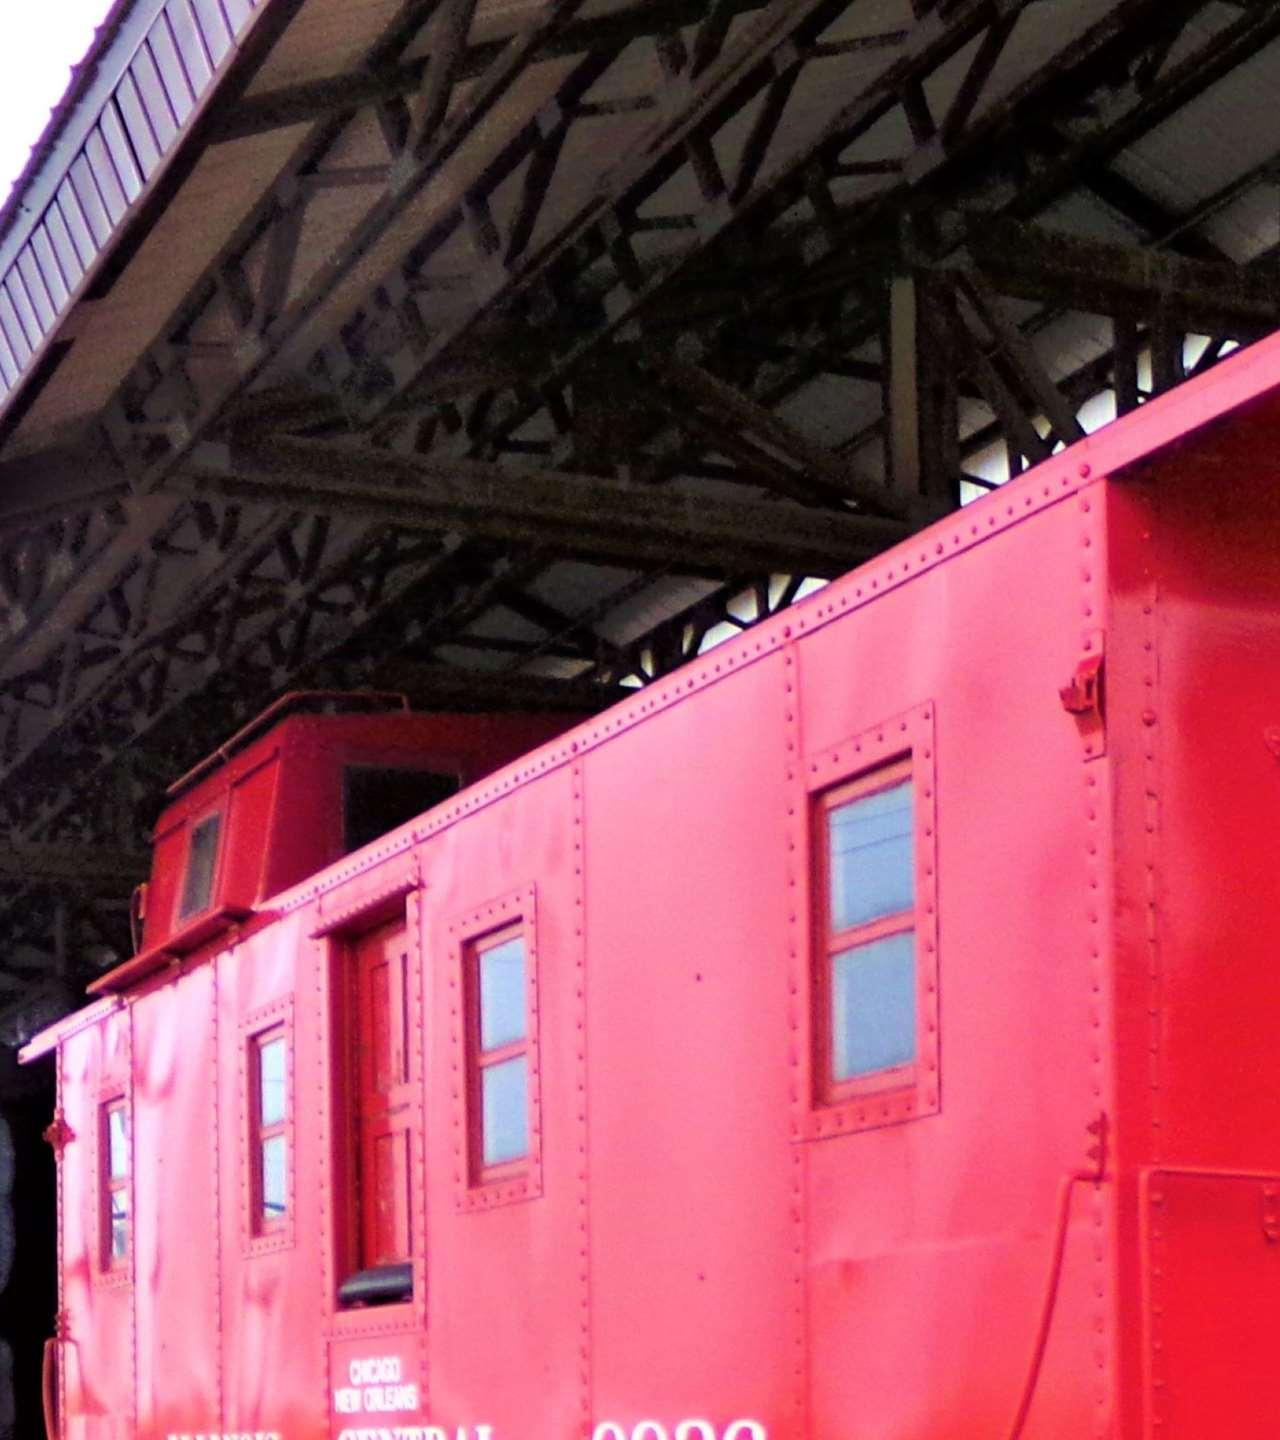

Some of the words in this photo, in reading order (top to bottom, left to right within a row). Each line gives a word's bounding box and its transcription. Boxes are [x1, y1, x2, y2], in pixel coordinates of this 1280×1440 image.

[349, 1356, 401, 1386] CHICAGO
[334, 1388, 361, 1414] NEW
[363, 1384, 418, 1412] ORLEANS
